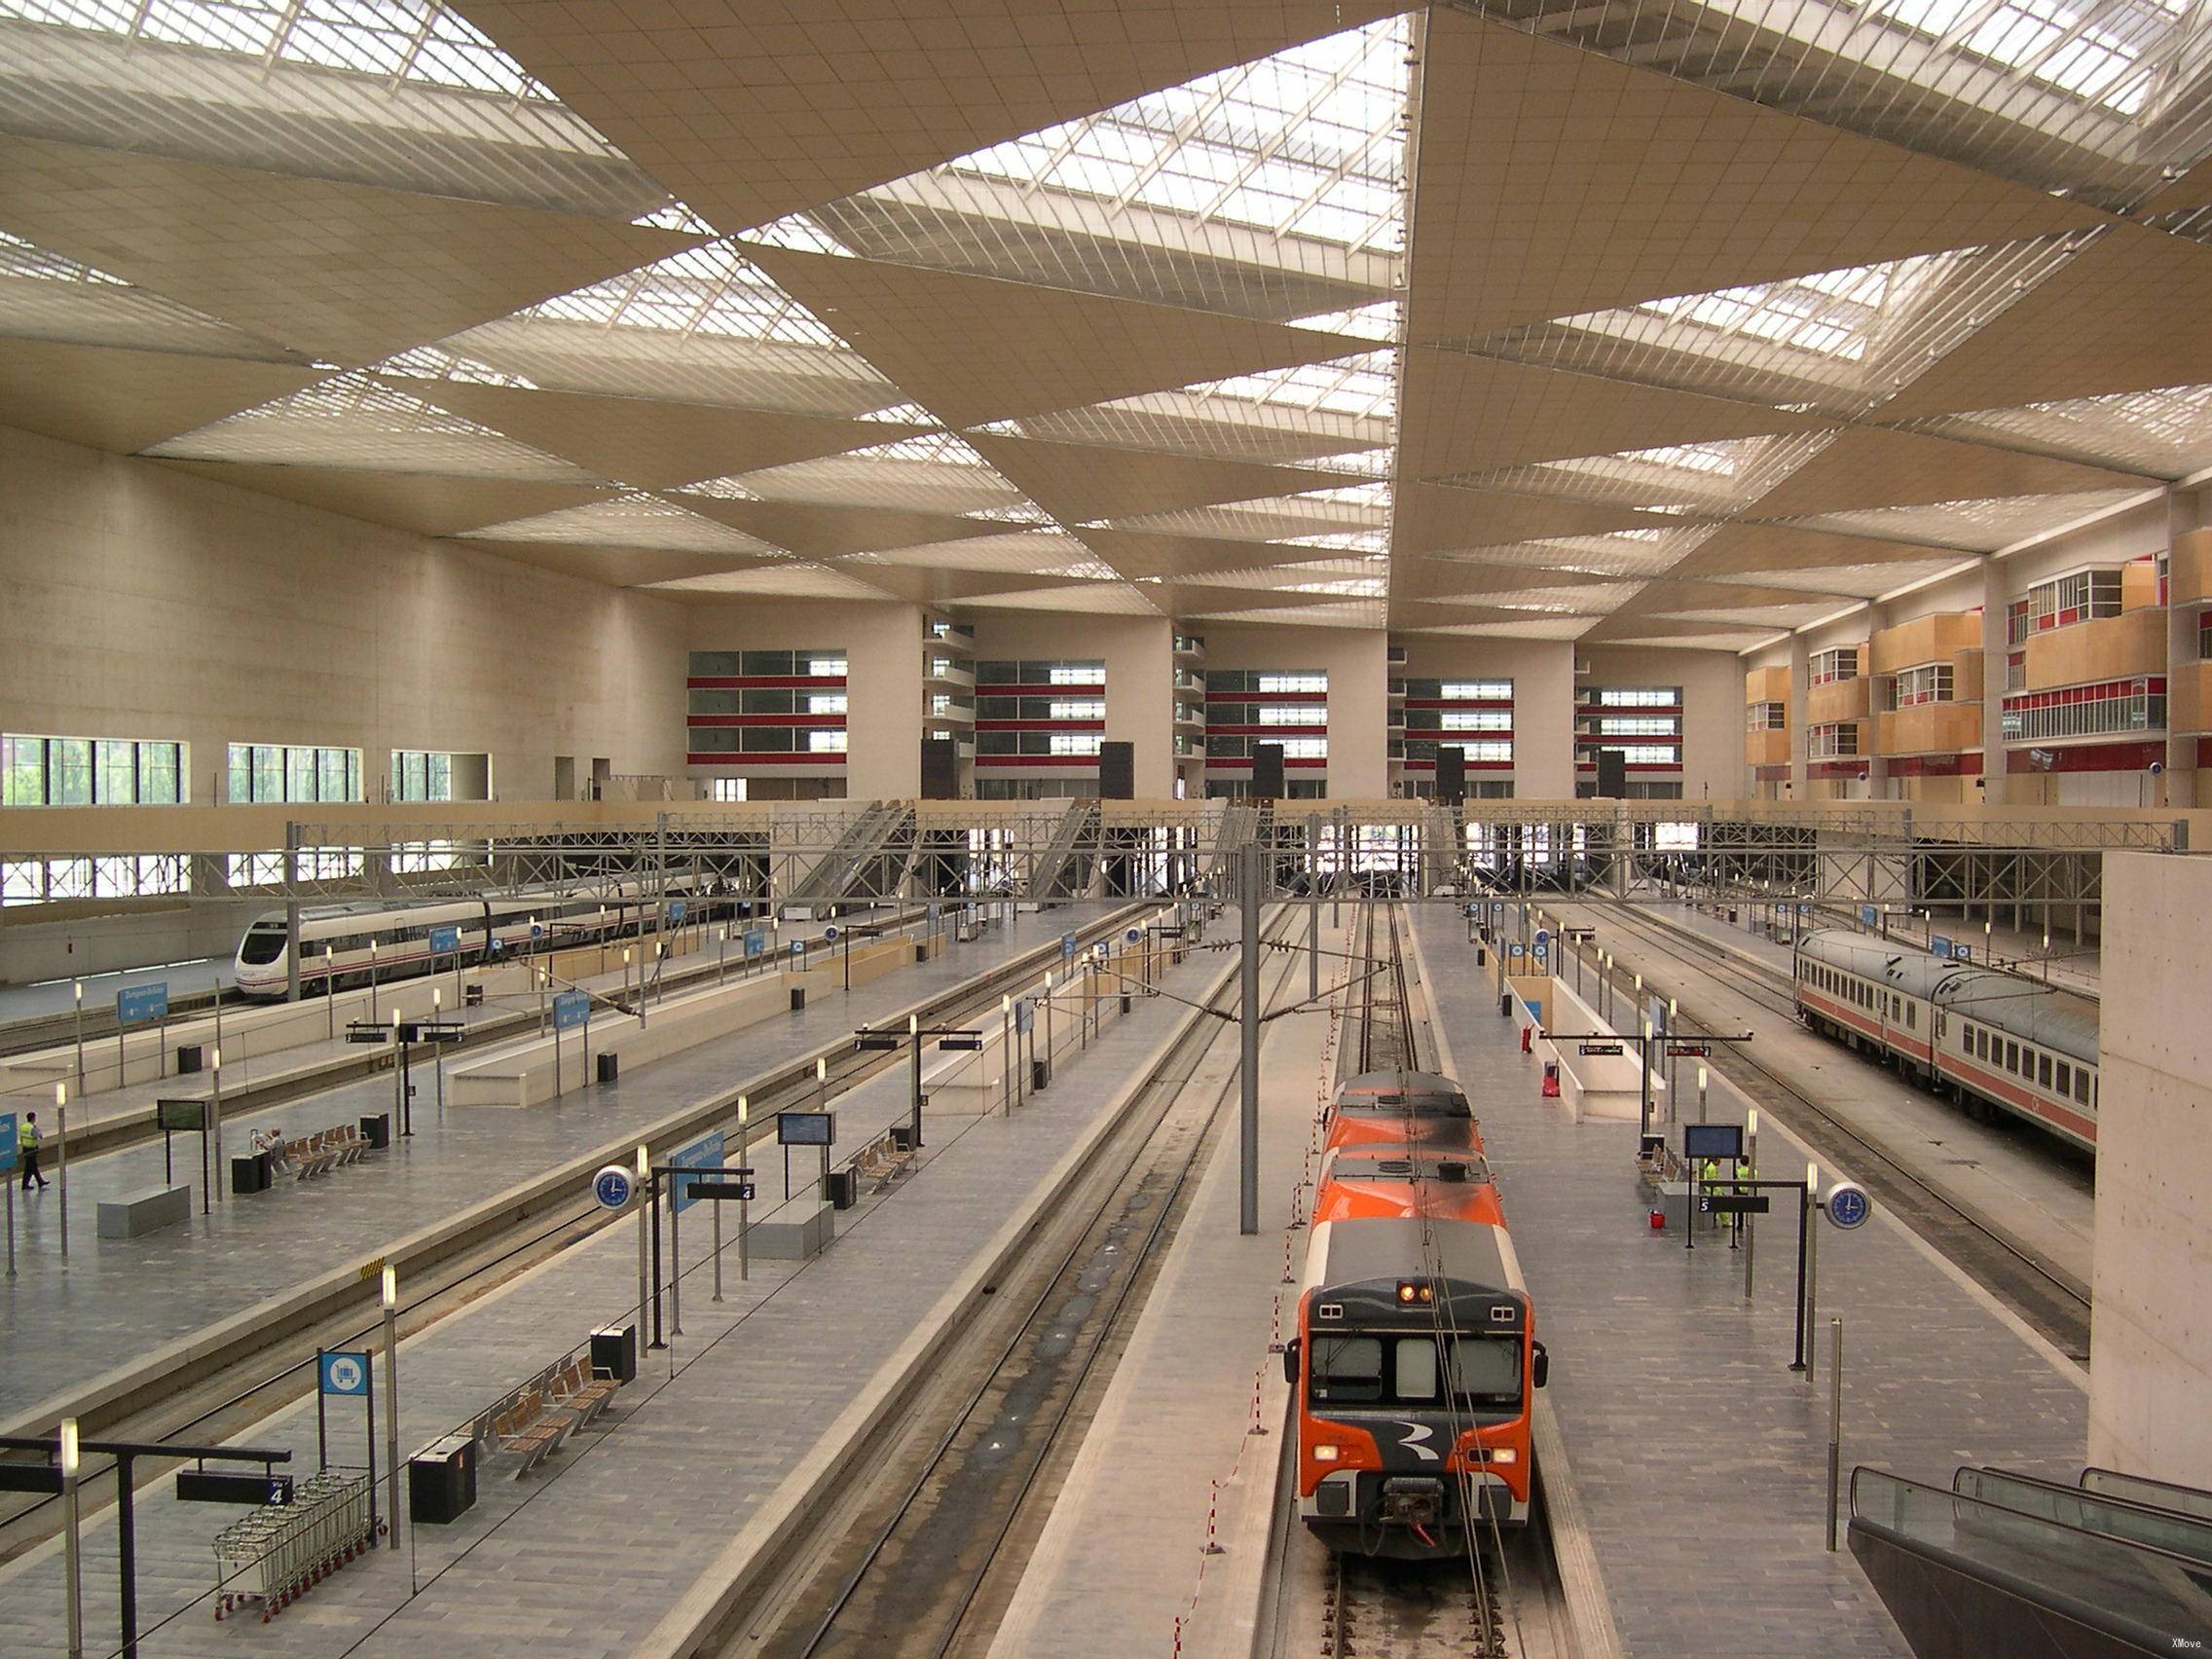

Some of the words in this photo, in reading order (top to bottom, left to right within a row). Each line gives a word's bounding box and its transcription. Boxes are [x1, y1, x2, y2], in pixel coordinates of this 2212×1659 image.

[743, 1189, 751, 1199] 4
[1700, 1201, 1709, 1211] 5
[271, 1489, 282, 1504] 4
